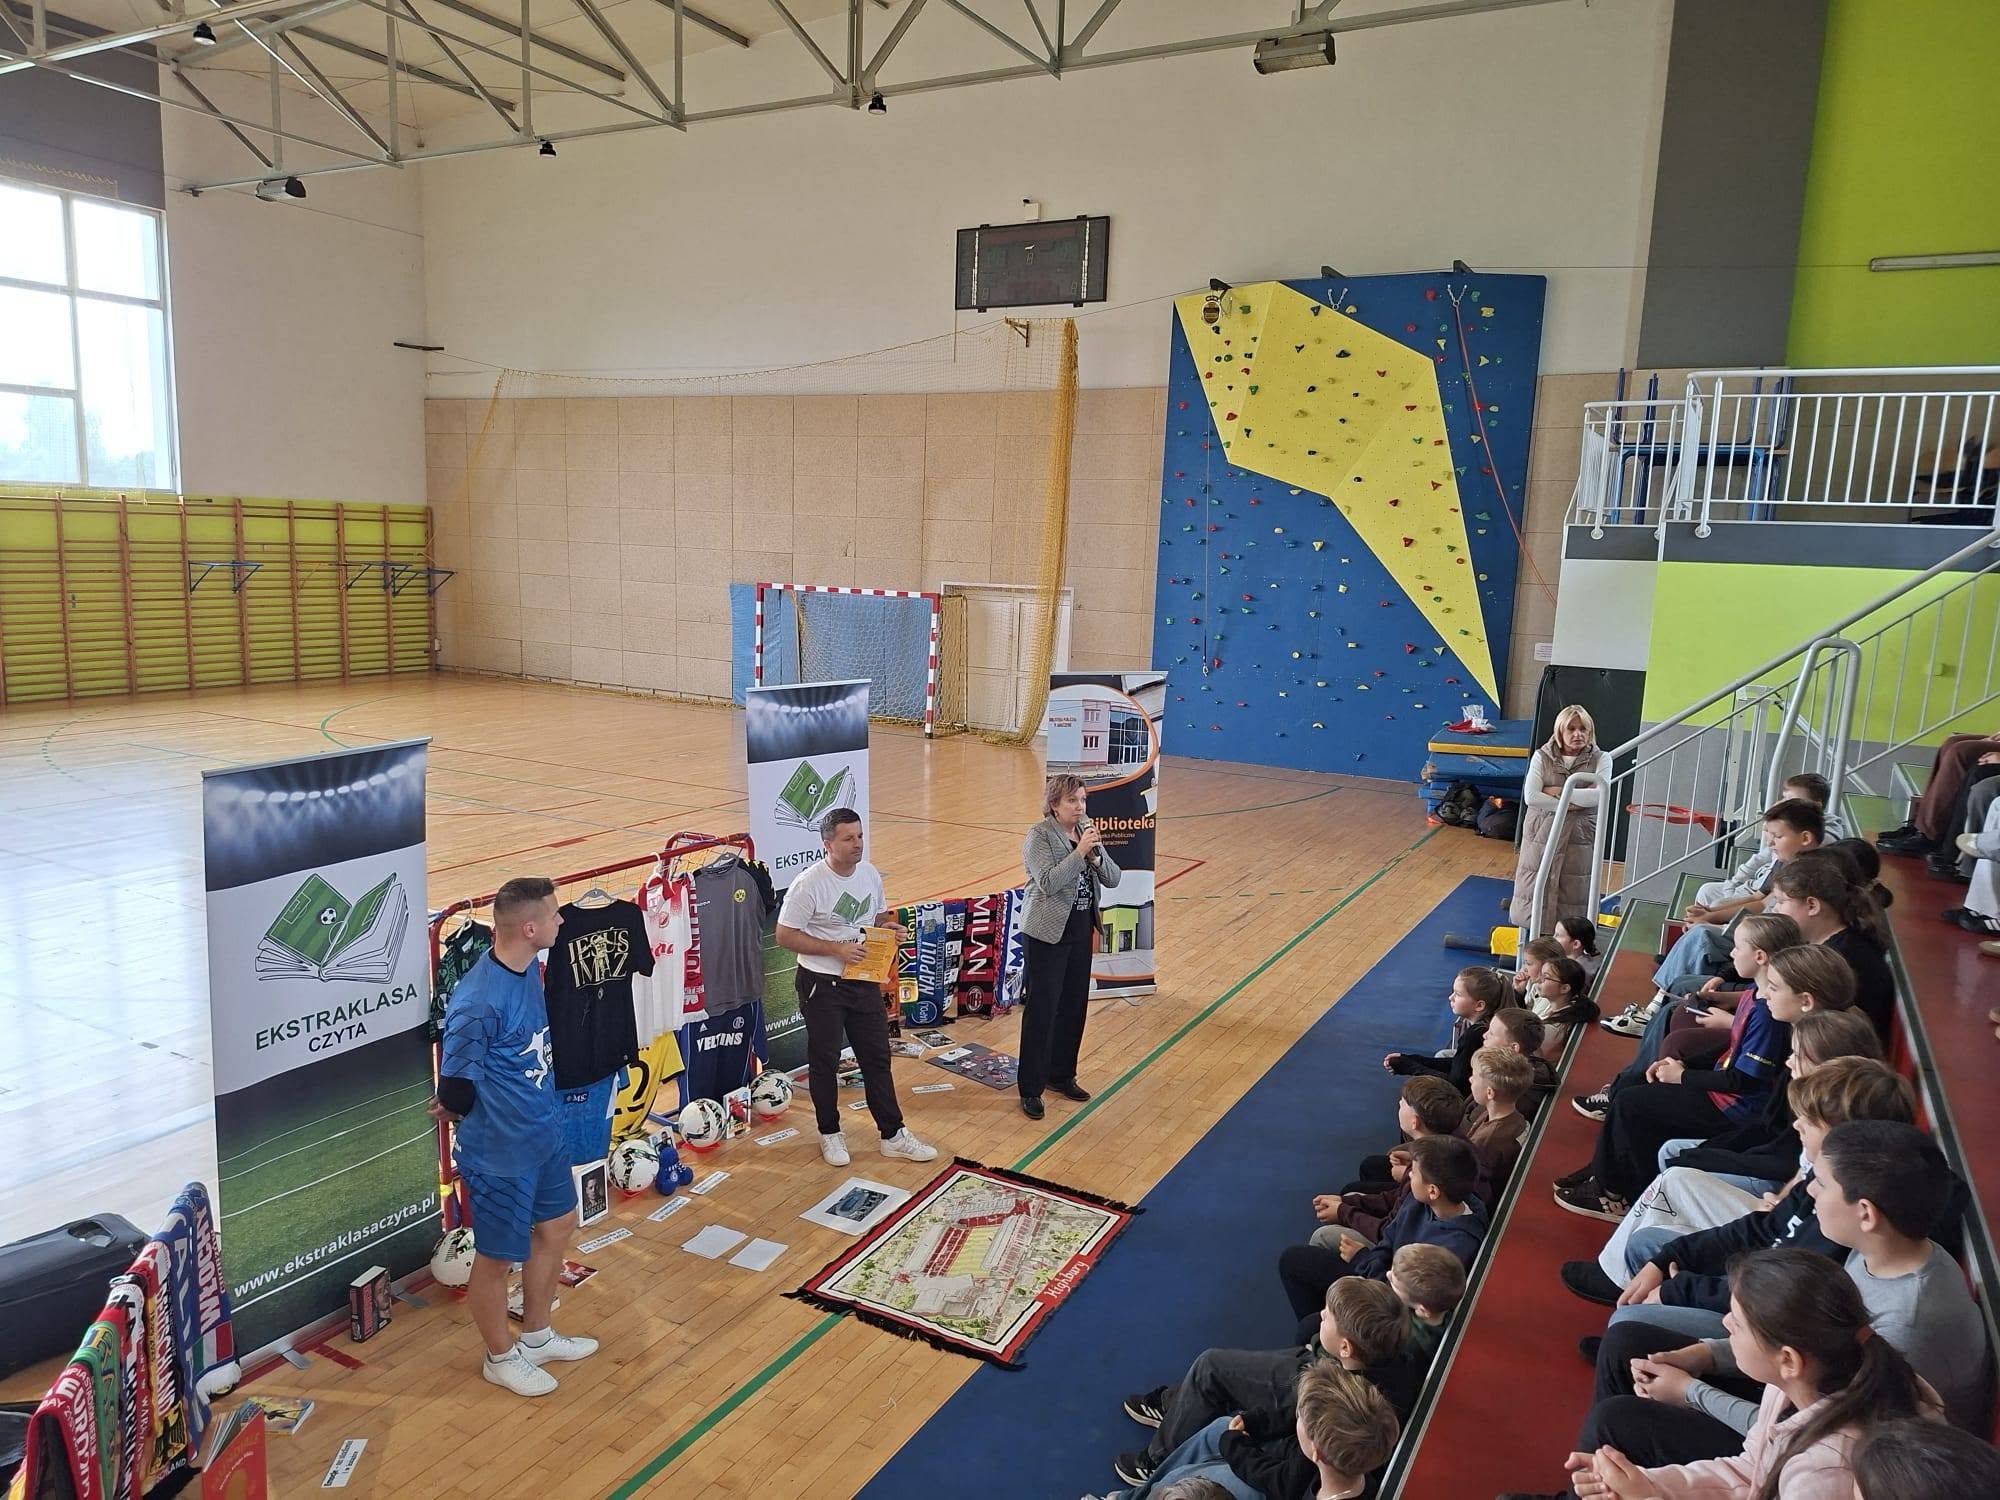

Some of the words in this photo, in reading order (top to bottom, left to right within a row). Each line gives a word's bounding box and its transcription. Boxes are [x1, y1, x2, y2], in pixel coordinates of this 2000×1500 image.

[775, 848, 829, 870] EKSTRAK
[952, 914, 960, 931] CUP
[967, 896, 990, 975] MILAN
[568, 930, 630, 964] JESUS
[571, 952, 629, 988] IMAZ
[918, 941, 937, 995] NAPOLI
[255, 983, 418, 1051] EKSTRAKLASA
[308, 1022, 368, 1052] CZYTA
[696, 1032, 743, 1052] VELTINS
[234, 1192, 435, 1298] www.ekstraklasaczyta.pl
[196, 1206, 221, 1334] WŁOCHY
[1043, 1261, 1090, 1299] Highbury
[156, 1283, 176, 1416] DEUTSCHLAND
